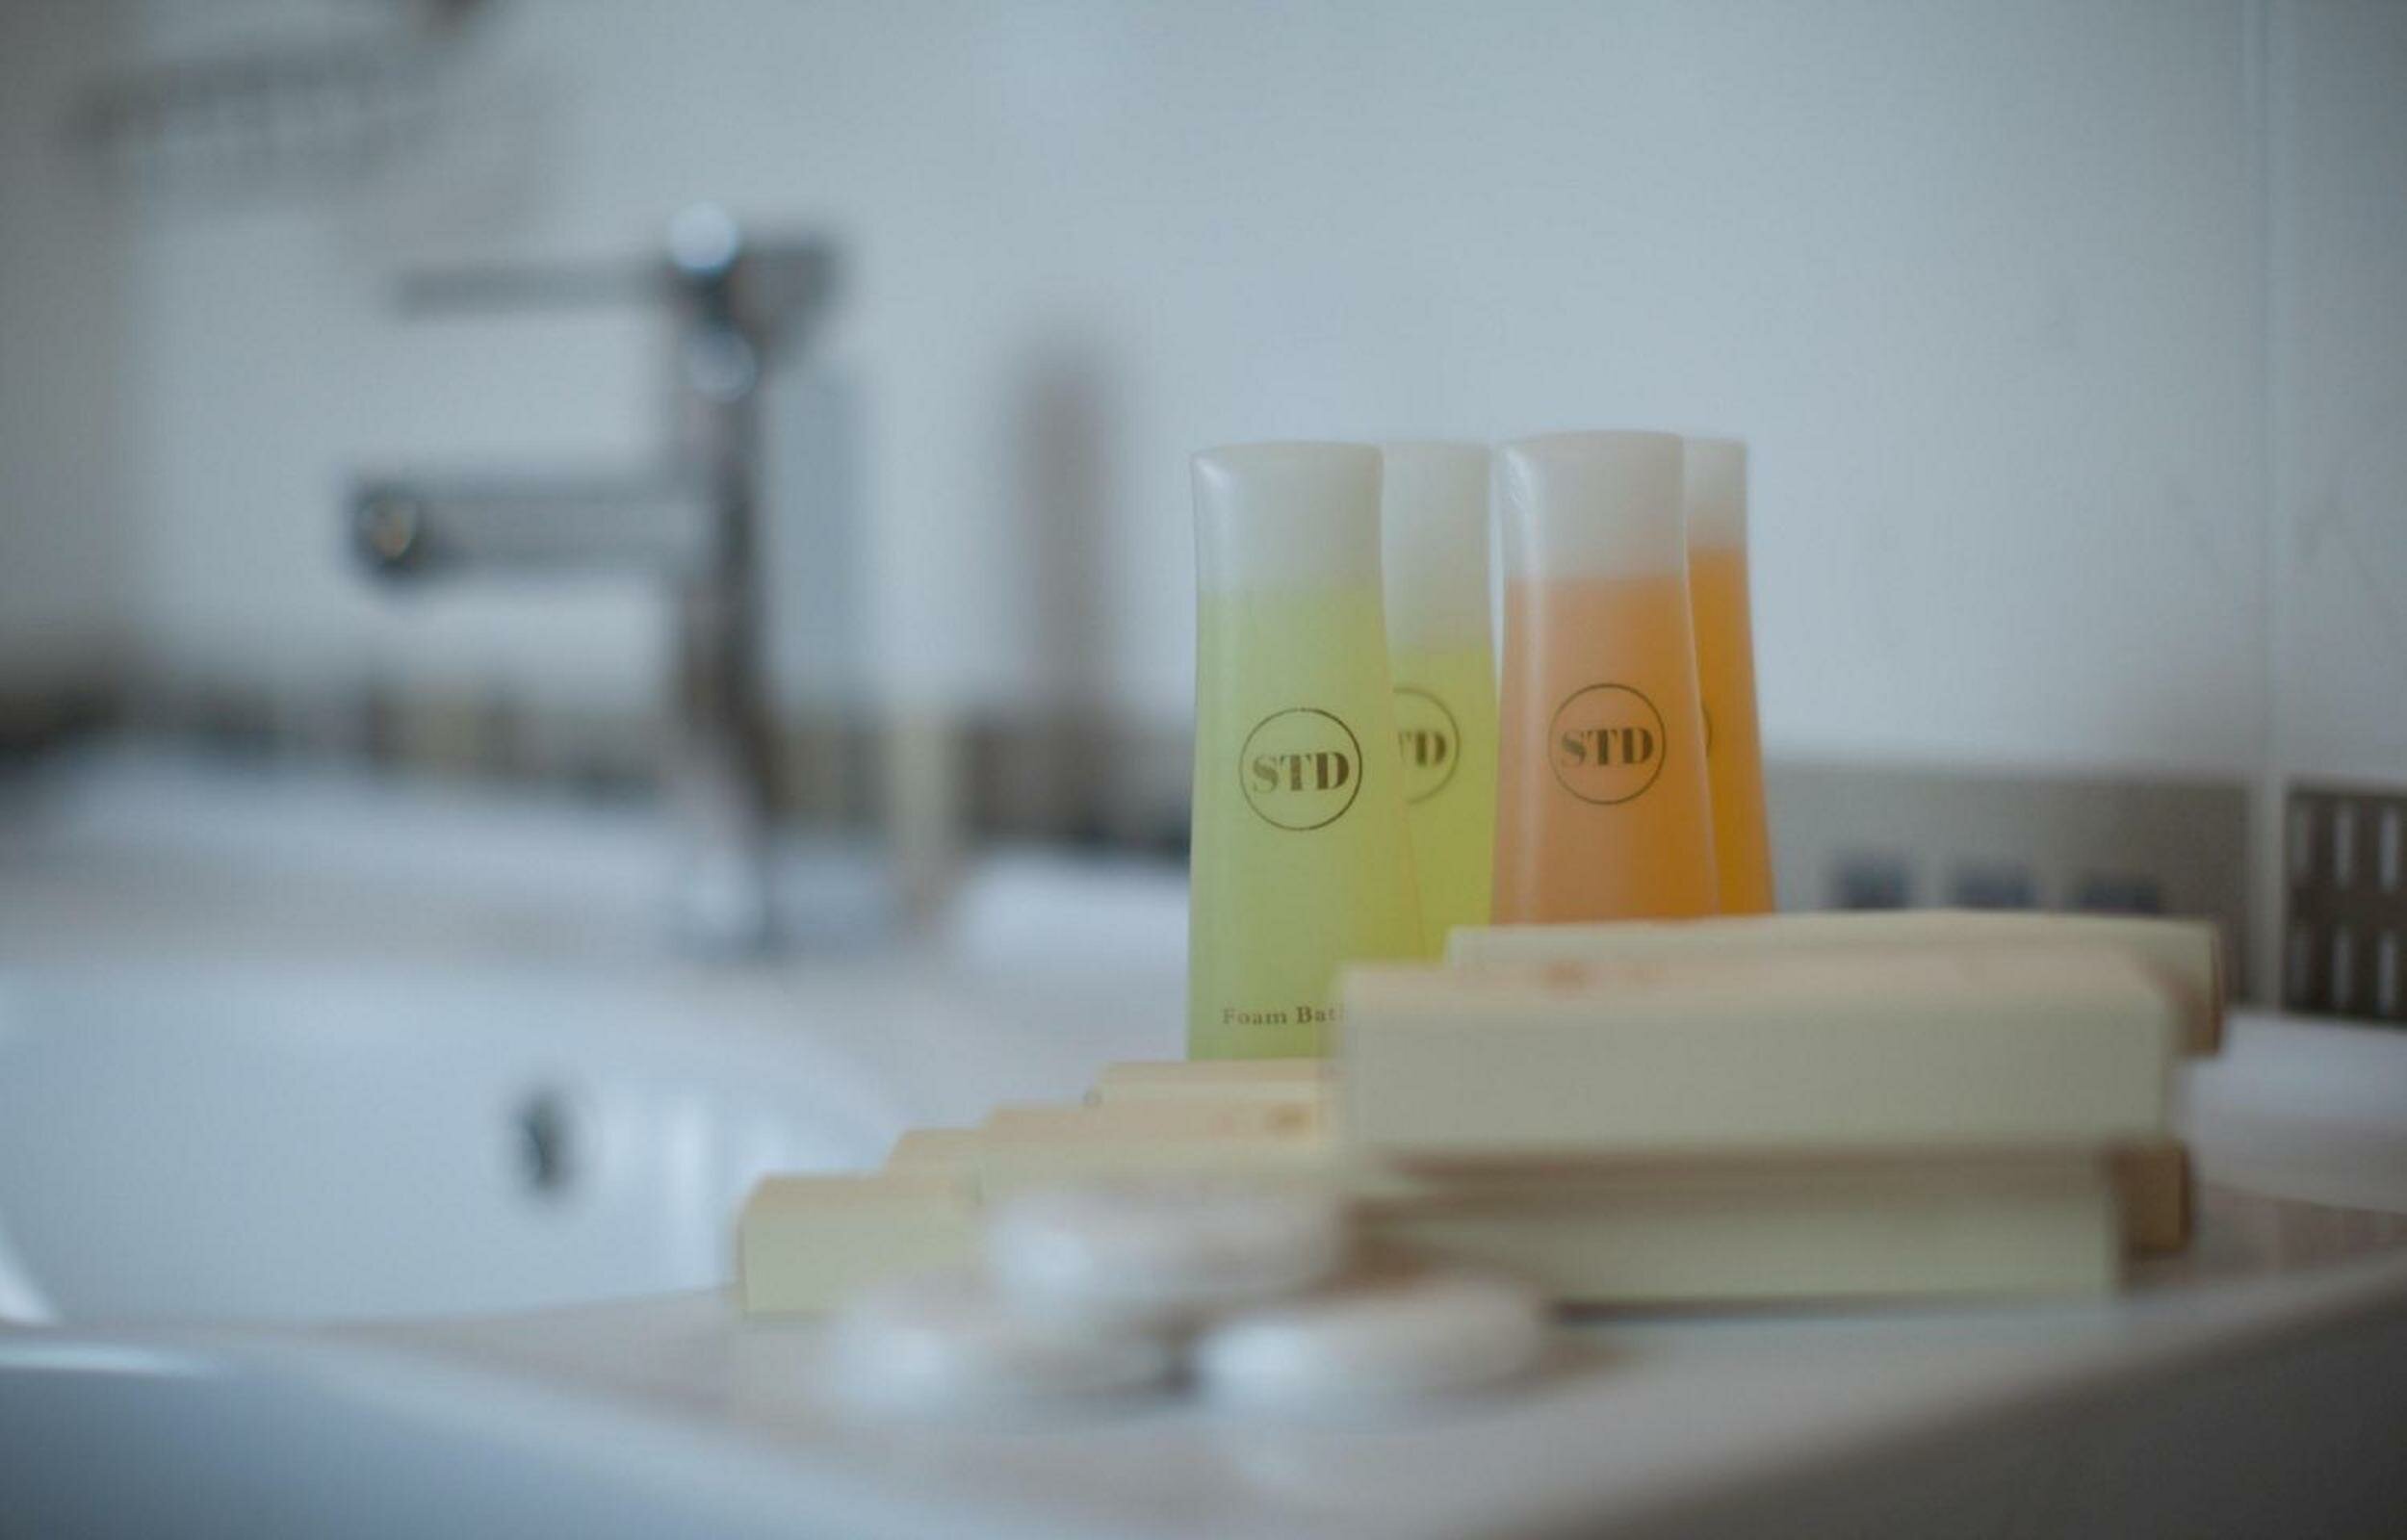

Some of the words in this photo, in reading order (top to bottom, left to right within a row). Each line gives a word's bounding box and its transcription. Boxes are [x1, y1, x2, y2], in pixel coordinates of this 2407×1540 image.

[1561, 727, 1653, 768] STD
[1253, 752, 1350, 793] STD
[1222, 1007, 1287, 1025] Foam
